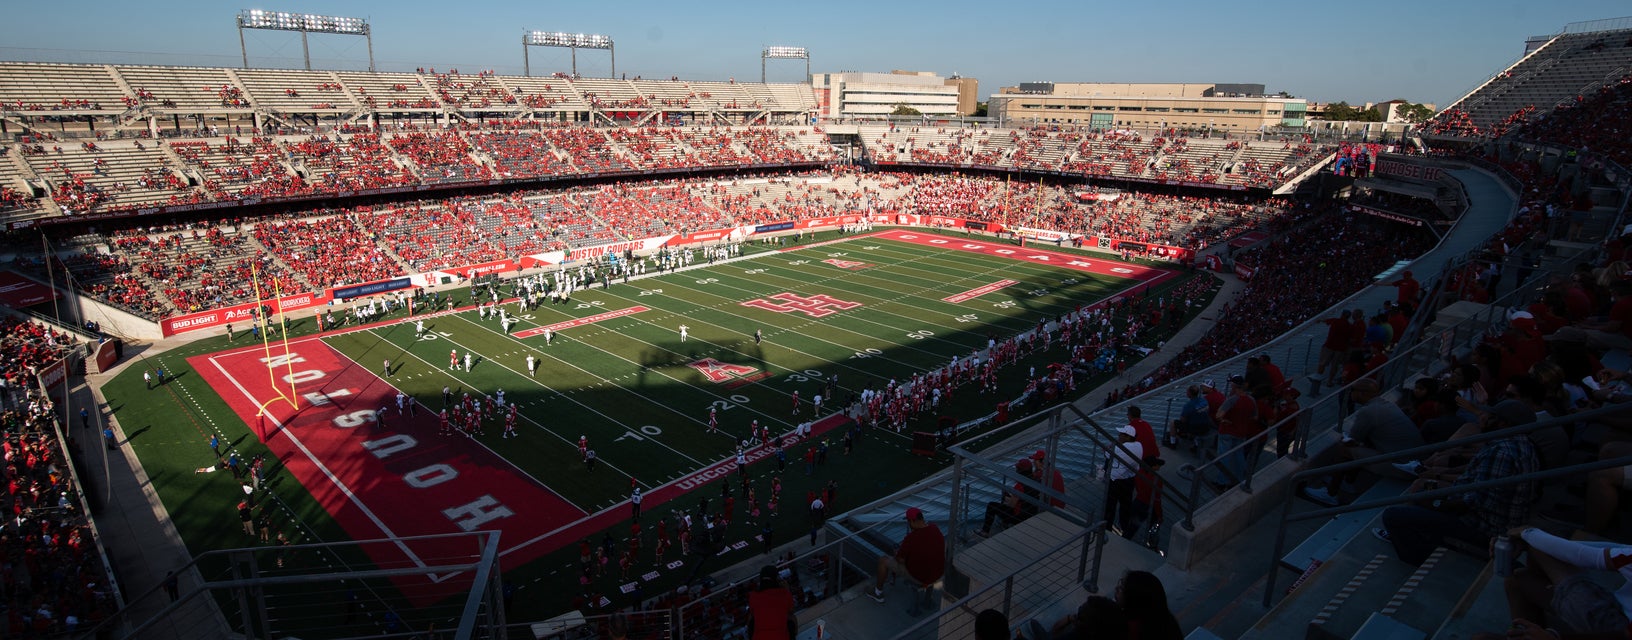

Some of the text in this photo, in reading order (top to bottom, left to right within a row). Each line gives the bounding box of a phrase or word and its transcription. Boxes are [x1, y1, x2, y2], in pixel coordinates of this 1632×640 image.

[1377, 160, 1420, 179] WHOSE
[899, 234, 1134, 275] COUGARS
[172, 315, 216, 329] BUD LIGHT
[906, 330, 935, 340] 50
[853, 348, 883, 359] 40
[788, 368, 823, 383] 30
[710, 394, 751, 411] 20
[258, 351, 516, 533] HOUSTON
[619, 425, 662, 442] 10
